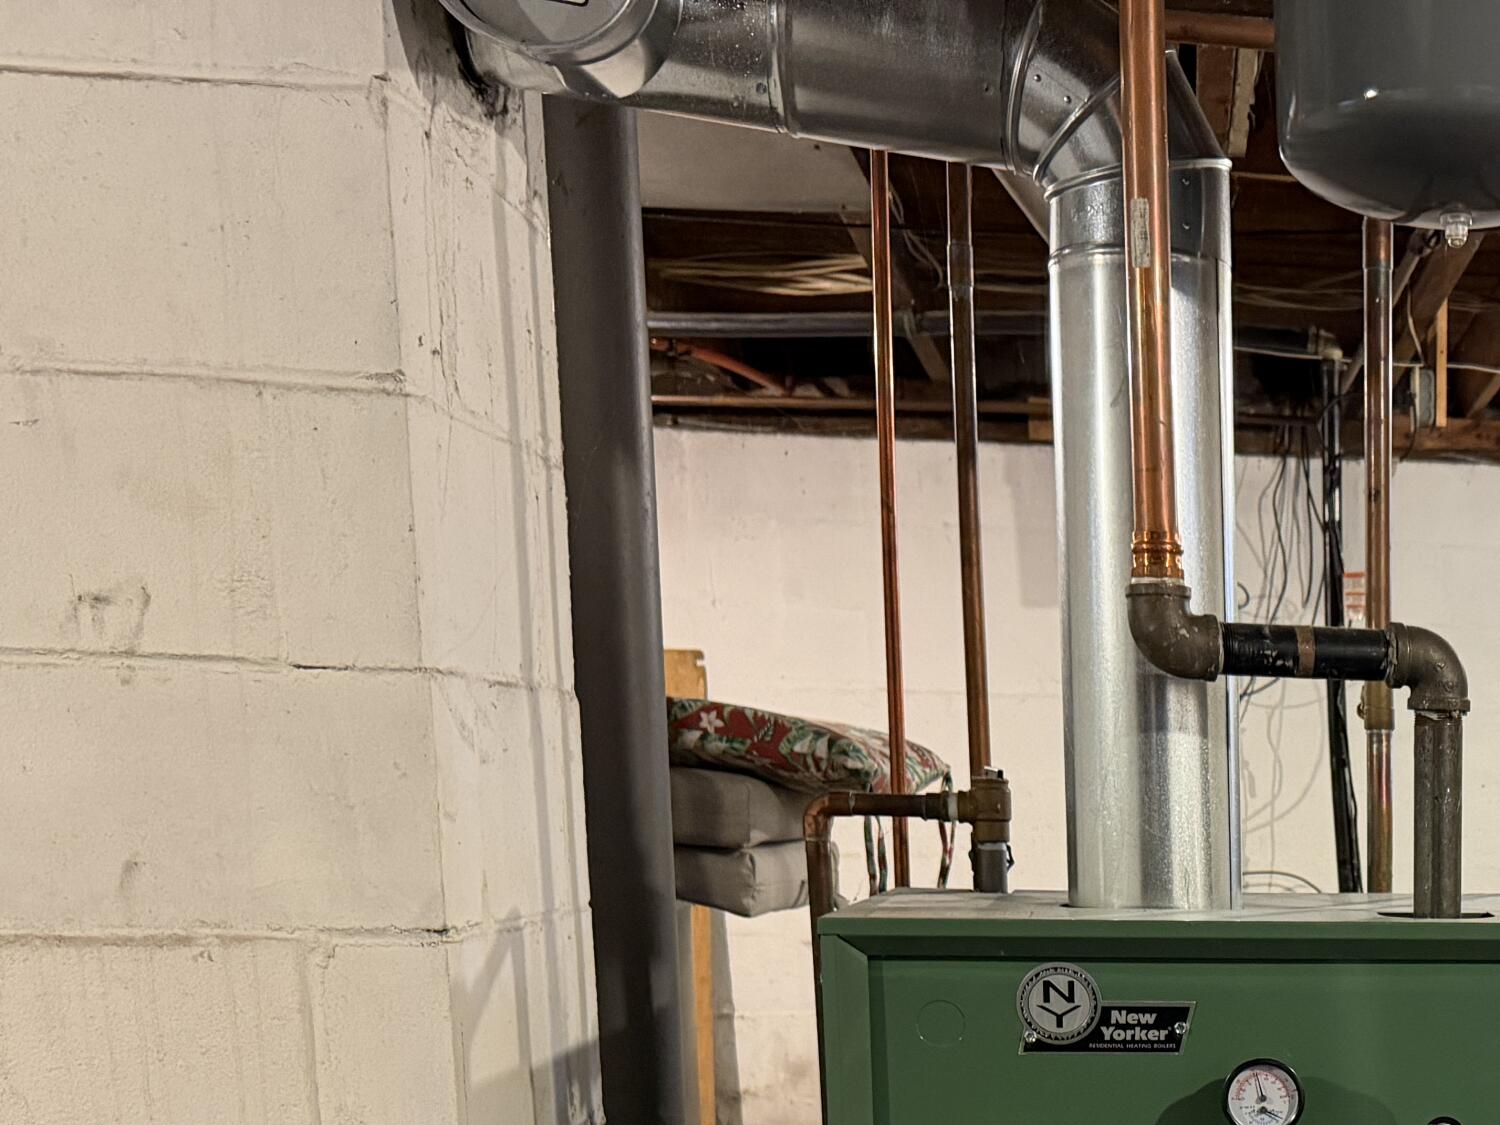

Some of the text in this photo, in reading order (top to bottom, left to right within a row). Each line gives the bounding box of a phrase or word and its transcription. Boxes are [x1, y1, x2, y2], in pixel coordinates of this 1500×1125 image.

[1043, 980, 1074, 1004] N
[1036, 1004, 1082, 1028] Y
[1110, 1010, 1158, 1024] New
[1100, 1026, 1169, 1041] Yorker
